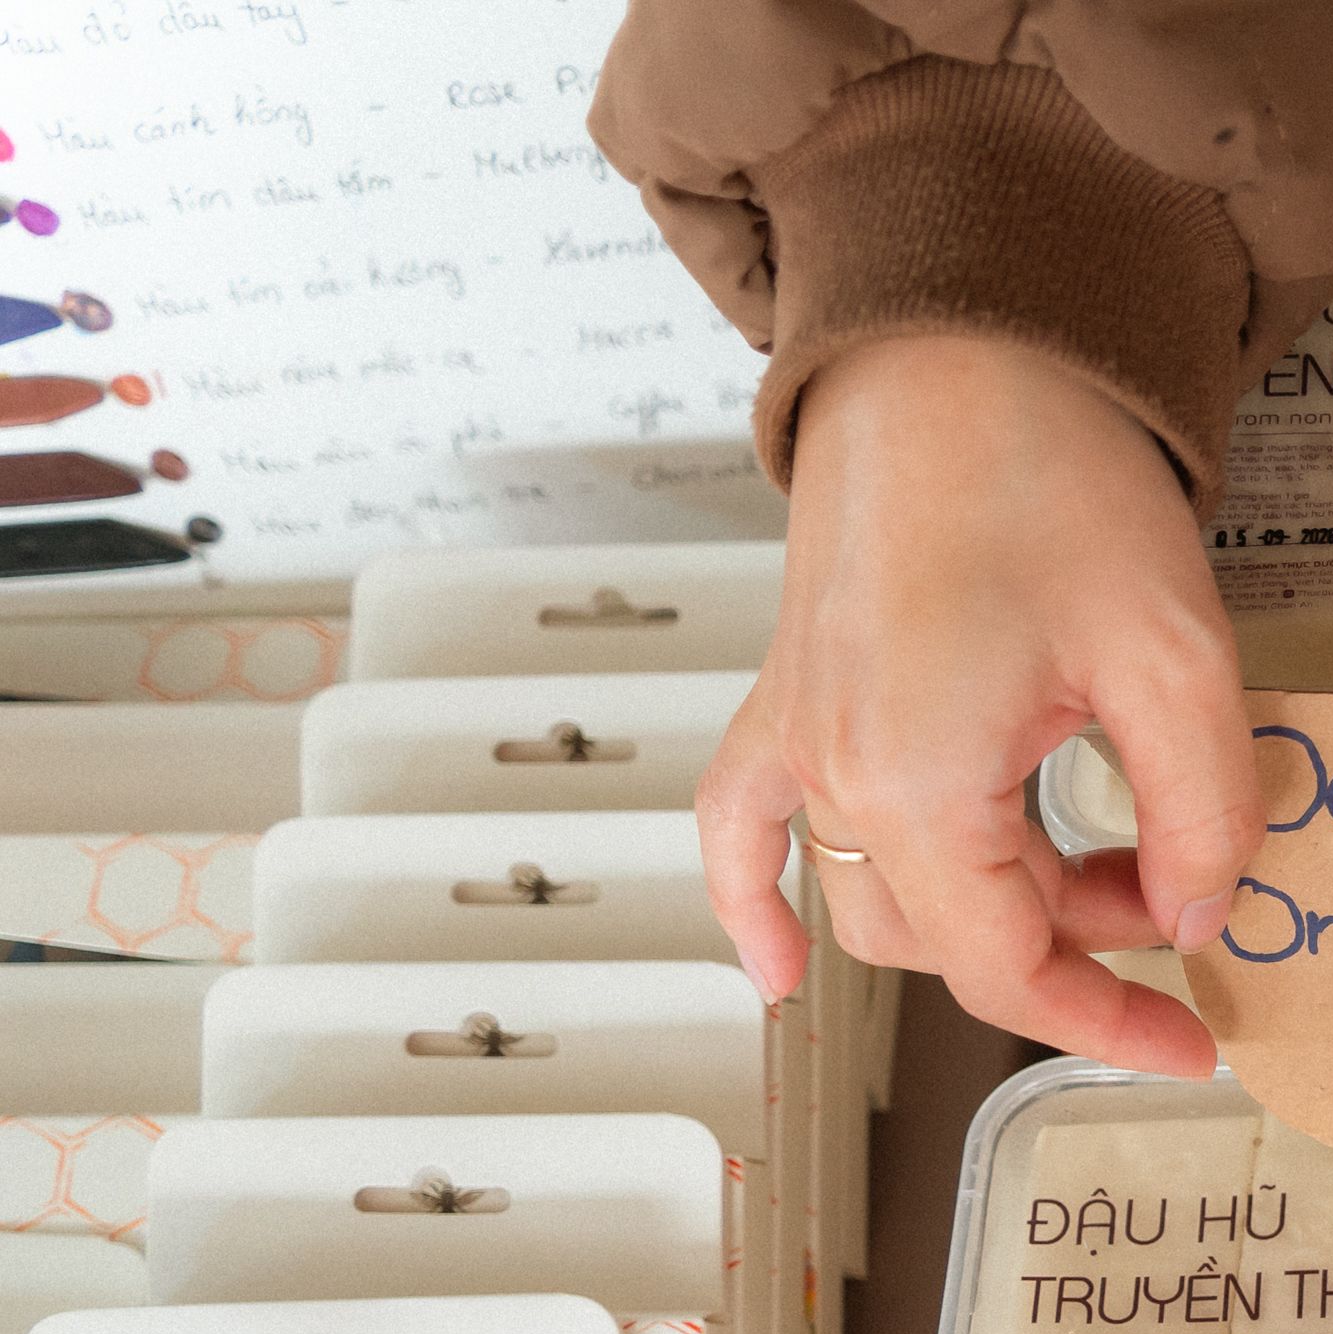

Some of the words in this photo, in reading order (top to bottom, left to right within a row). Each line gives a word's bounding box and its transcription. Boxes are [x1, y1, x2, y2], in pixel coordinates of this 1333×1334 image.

[1289, 412, 1333, 427] non
[1026, 1188, 1166, 1257] ĐẬU
[1198, 1184, 1287, 1243] HŨ
[1021, 1256, 1262, 1324] TRUYỀN
